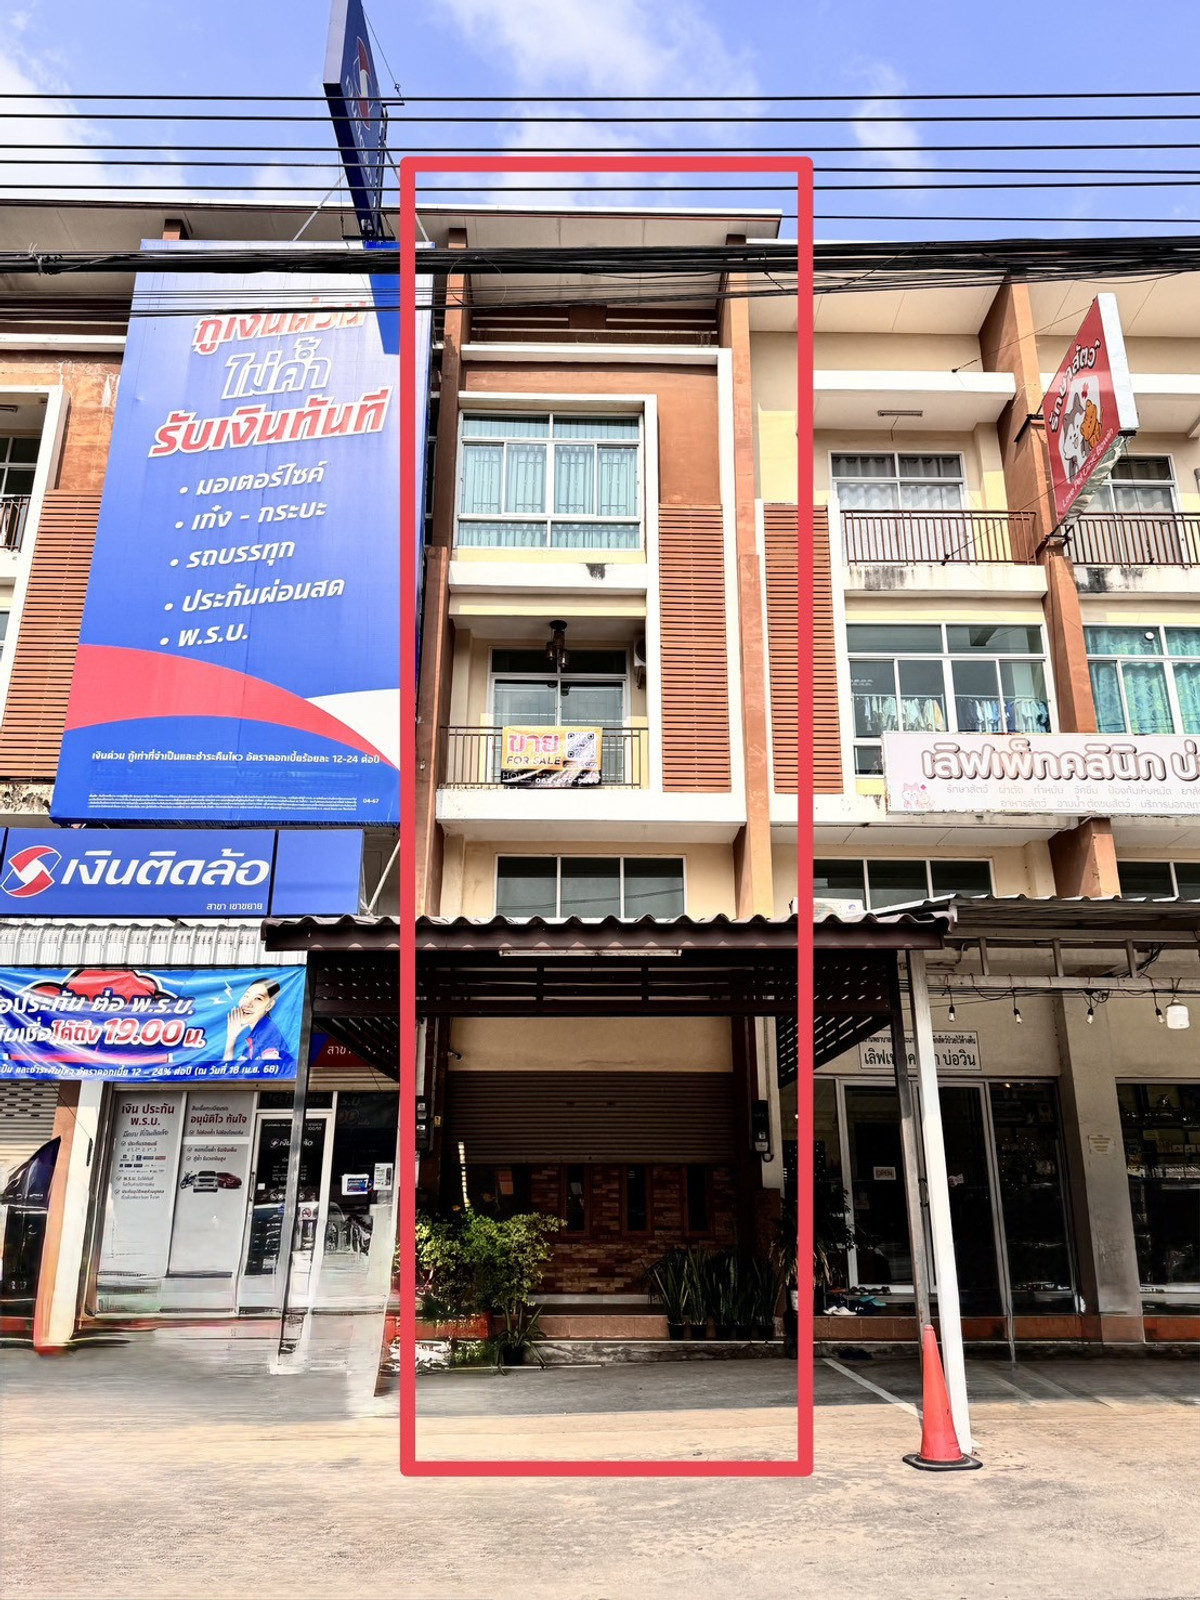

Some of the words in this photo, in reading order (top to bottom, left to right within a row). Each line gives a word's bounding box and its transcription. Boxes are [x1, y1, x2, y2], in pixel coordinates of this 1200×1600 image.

[221, 335, 332, 400] ไม่ค้ำ
[1048, 338, 1101, 433] รักษาสัตว์
[148, 385, 393, 457] รับเงินทันที
[195, 460, 328, 496] มอเตอร์ไซค์
[191, 504, 233, 531] เก๋ง
[257, 501, 328, 524] กระบะ
[186, 540, 296, 569] รถบรรทุก
[181, 578, 346, 613] ประกันผ่อนสด
[177, 623, 249, 647] พ.ร.บ.
[508, 734, 560, 753] ขาย
[91, 750, 126, 761] เงินด่วน
[332, 754, 358, 764] 12-24
[361, 753, 380, 764] ต่อปี
[506, 755, 530, 765] FOR
[533, 756, 561, 765] SALE
[921, 738, 1167, 781] เลิฟเพ็ทคลินิก
[1171, 739, 1200, 781] บ่
[946, 784, 989, 794] รักษาสัตว์
[60, 848, 270, 886] เงินติดล้อ
[206, 903, 227, 911] สาขา
[229, 903, 263, 911] เขาขยาย
[91, 988, 125, 1012] ต่อ
[132, 996, 195, 1015] พ.ร.บ.
[104, 1018, 186, 1046] 19.00
[184, 1028, 207, 1049] น.
[327, 1046, 352, 1055] สาข
[943, 1049, 976, 1066] บ่อวิน
[131, 1067, 142, 1075] 12
[152, 1067, 171, 1076] 24%
[174, 1066, 192, 1076] ต่อปี
[208, 1063, 228, 1075] วันที่
[229, 1065, 239, 1074] 18
[263, 1064, 279, 1074] 68)
[121, 1103, 138, 1114] เงิน
[142, 1103, 175, 1114] ประกัน
[226, 1113, 247, 1124] ทันใจ
[130, 1117, 160, 1126] พ.ร.บ.
